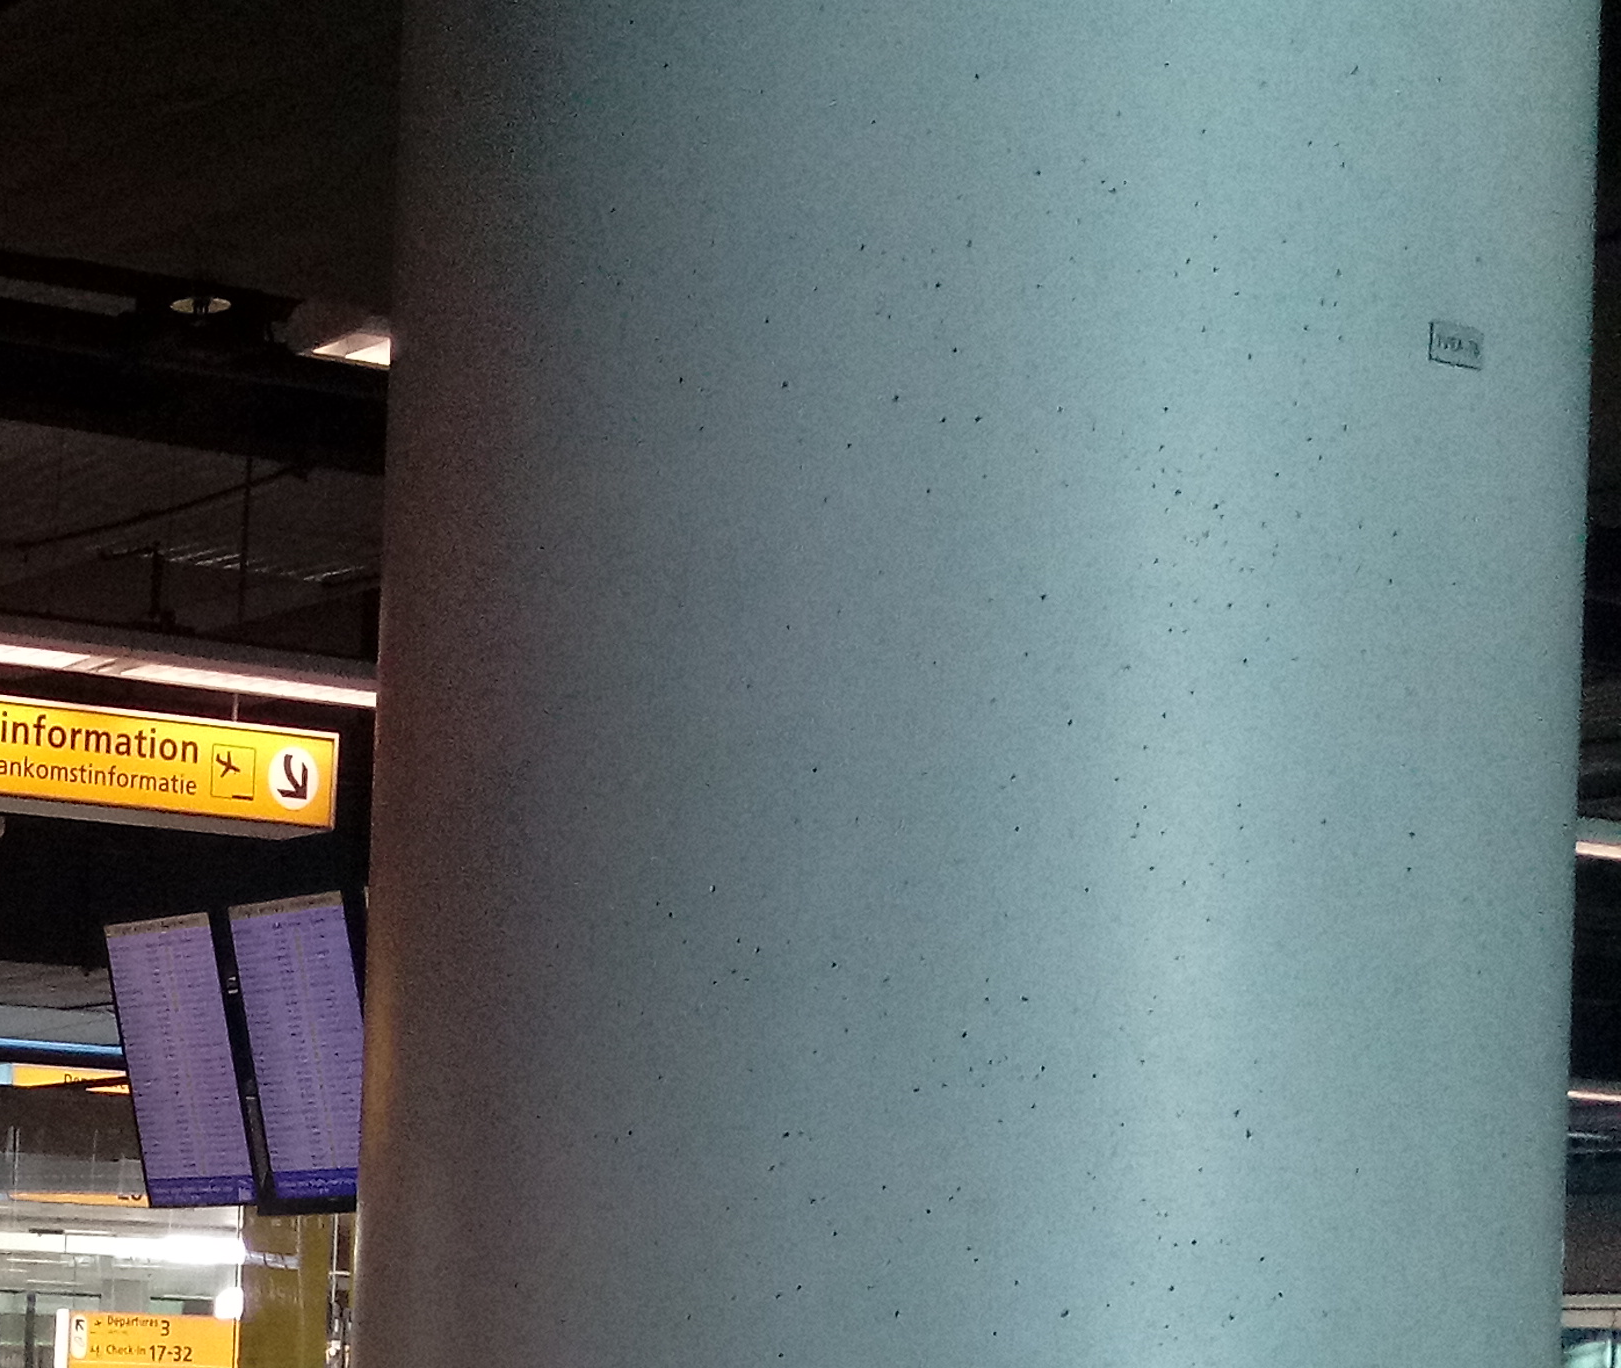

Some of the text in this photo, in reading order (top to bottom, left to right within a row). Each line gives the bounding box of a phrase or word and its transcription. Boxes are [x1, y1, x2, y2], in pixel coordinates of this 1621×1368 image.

[0, 710, 199, 764] information
[160, 1319, 171, 1337] 3
[148, 1344, 193, 1362] 17-32
